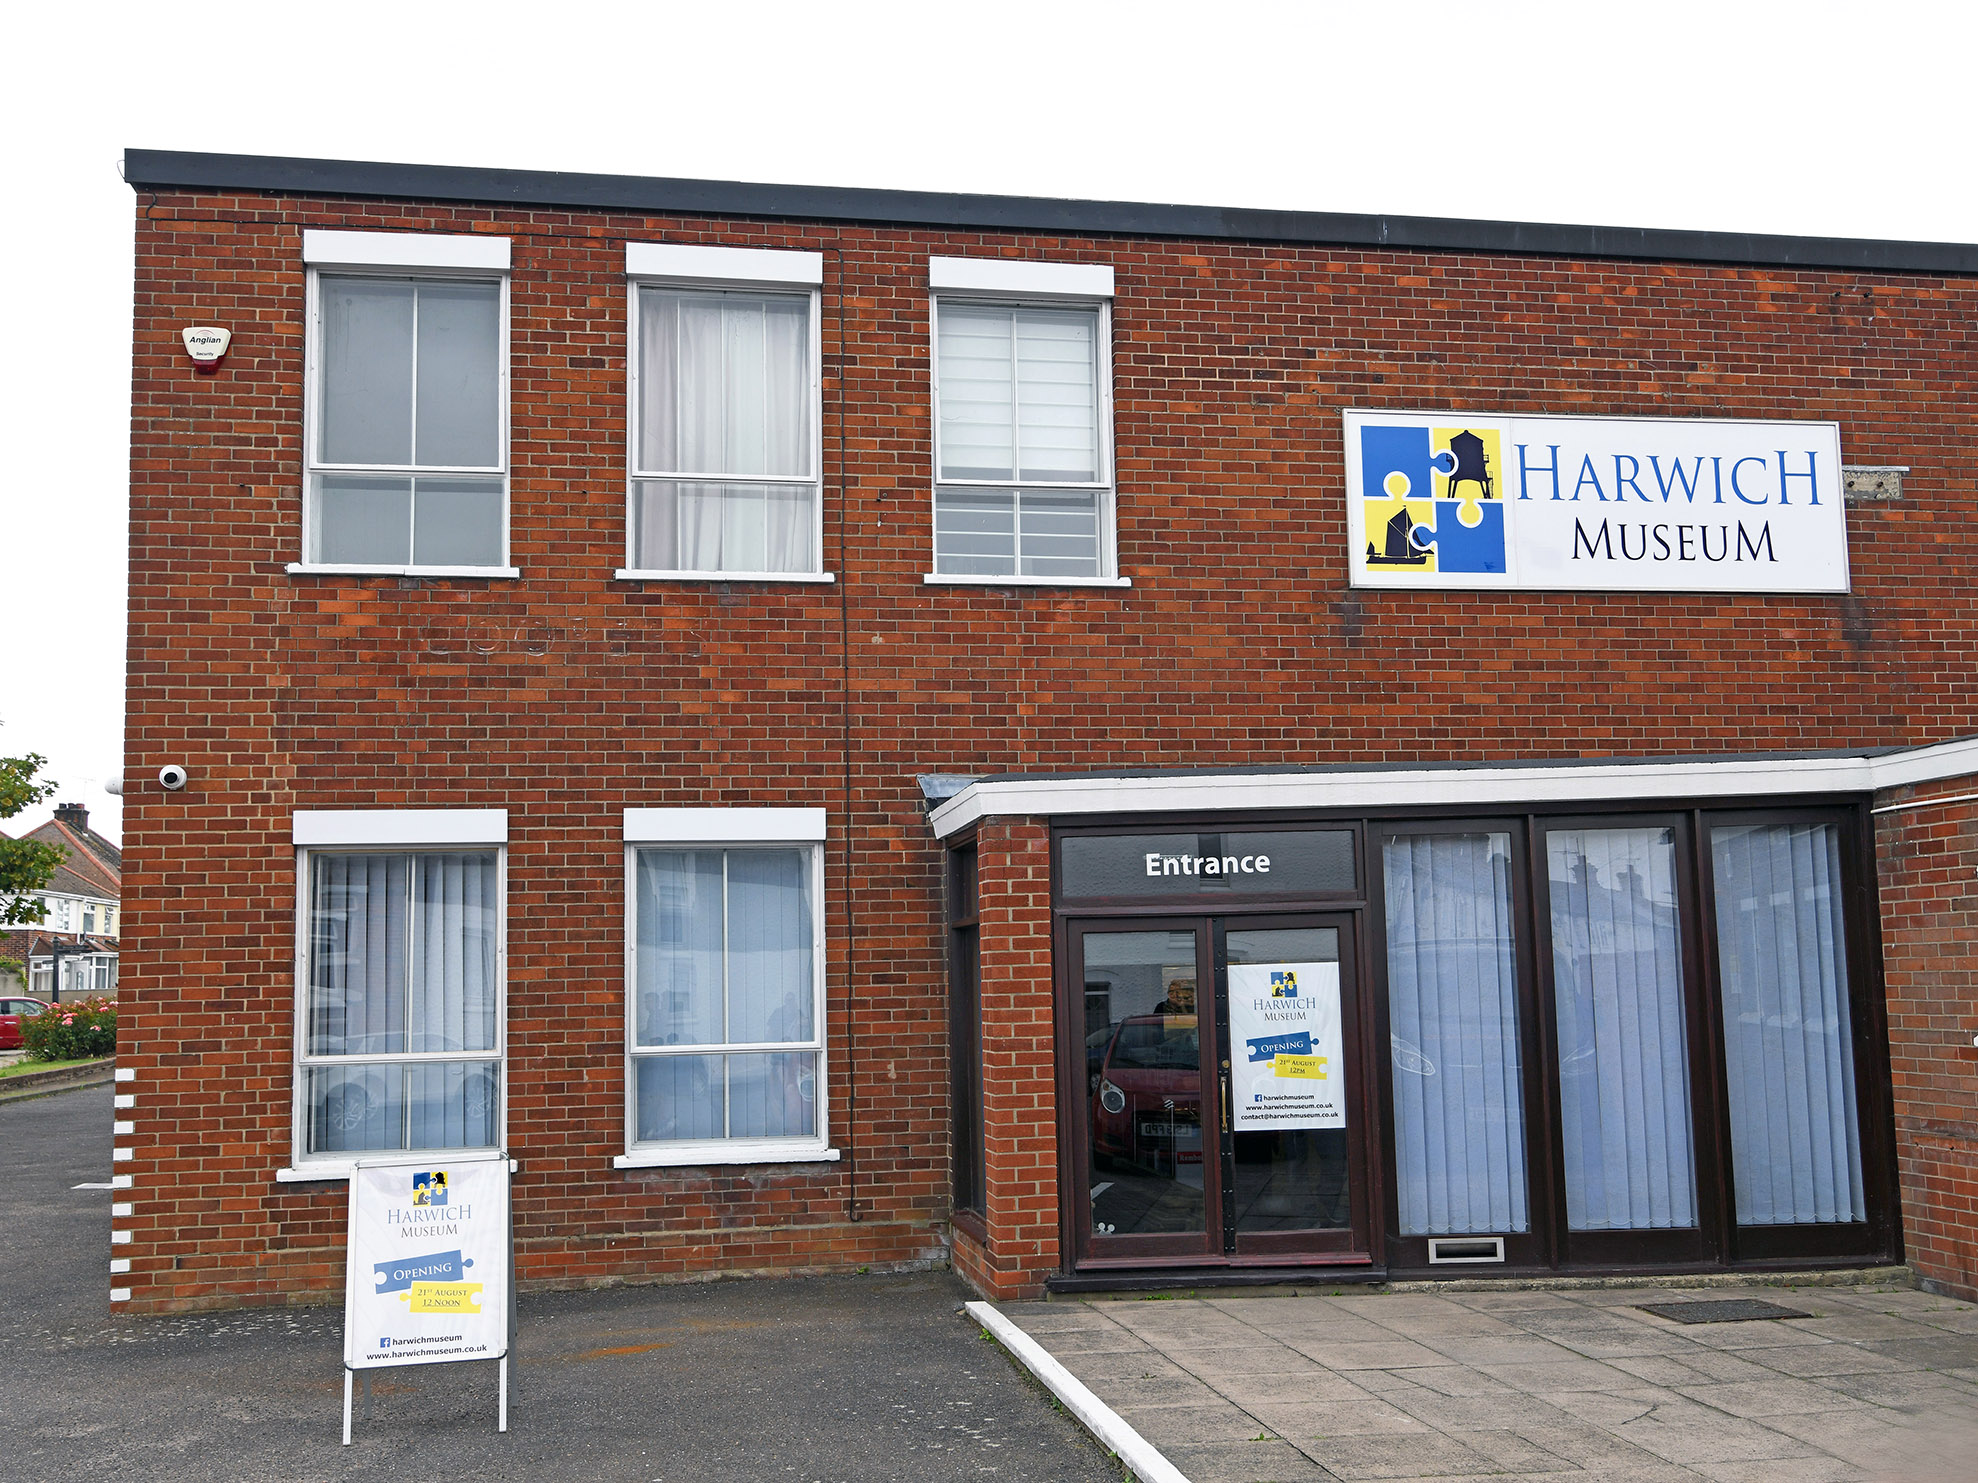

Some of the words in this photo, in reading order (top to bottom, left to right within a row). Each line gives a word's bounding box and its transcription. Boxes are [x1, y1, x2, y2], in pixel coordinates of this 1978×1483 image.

[189, 336, 221, 345] Anglian
[1513, 443, 1824, 506] HARWICH
[1571, 516, 1778, 562] MUSEUM
[1145, 853, 1271, 876] Entrance
[1253, 997, 1316, 1011] HARWICH
[1264, 1011, 1307, 1021] MUSEUM
[1260, 1040, 1304, 1053] OPENING
[1245, 1103, 1333, 1111] www.harwichmuseum.co.uk
[1240, 1112, 1339, 1120] contact@harwichmuseum.co.uk
[387, 1204, 472, 1224] HARWICH
[400, 1224, 458, 1238] MUSEUM
[393, 1262, 452, 1281] OPENING
[434, 1289, 467, 1297] AUGUST
[422, 1299, 432, 1307] 12
[434, 1299, 460, 1307] NOON
[392, 1334, 463, 1346] harwichmuseum
[366, 1345, 487, 1360] www.harwichmuseum.co.uk
